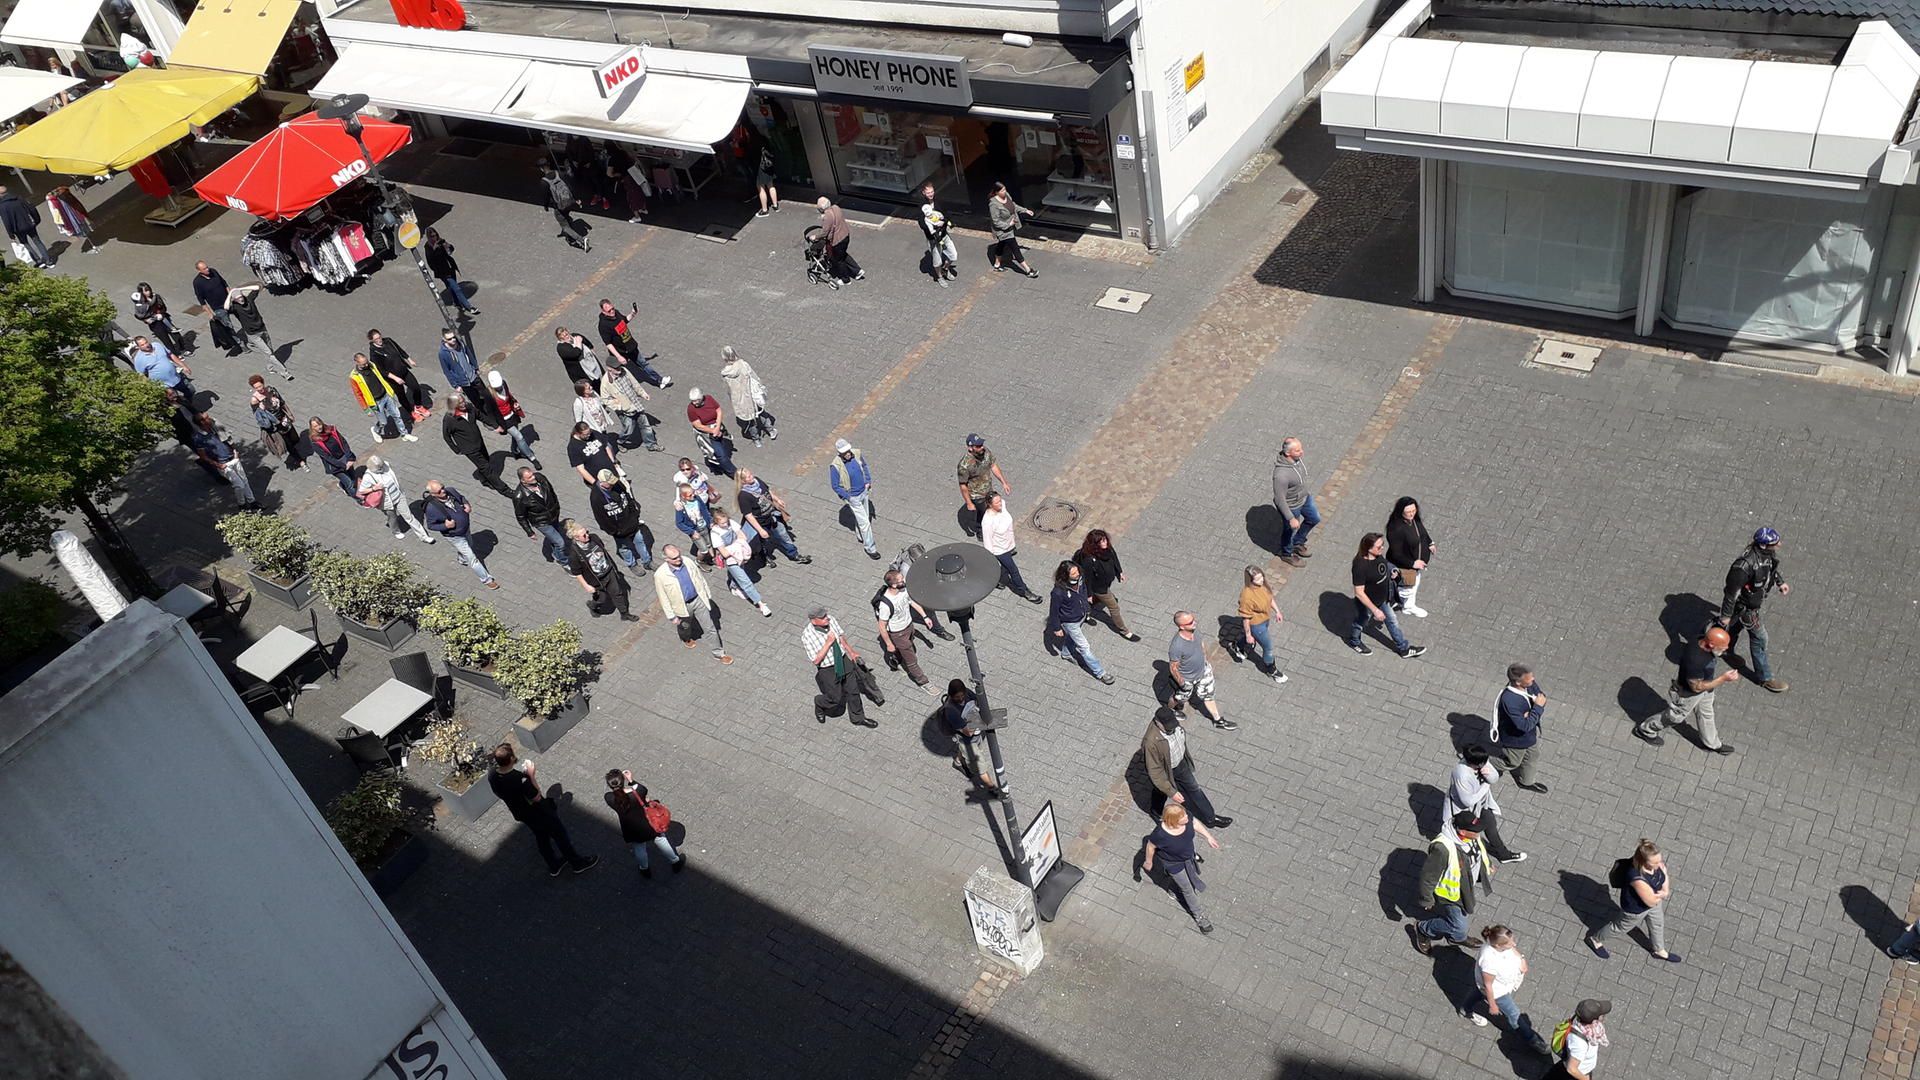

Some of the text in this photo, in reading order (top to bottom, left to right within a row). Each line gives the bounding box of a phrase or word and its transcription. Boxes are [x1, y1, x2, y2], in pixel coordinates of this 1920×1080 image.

[604, 56, 639, 90] NKD
[815, 56, 957, 88] HONEY PHONE
[887, 85, 903, 93] 1999
[331, 159, 367, 187] NKD
[225, 195, 248, 211] NKD
